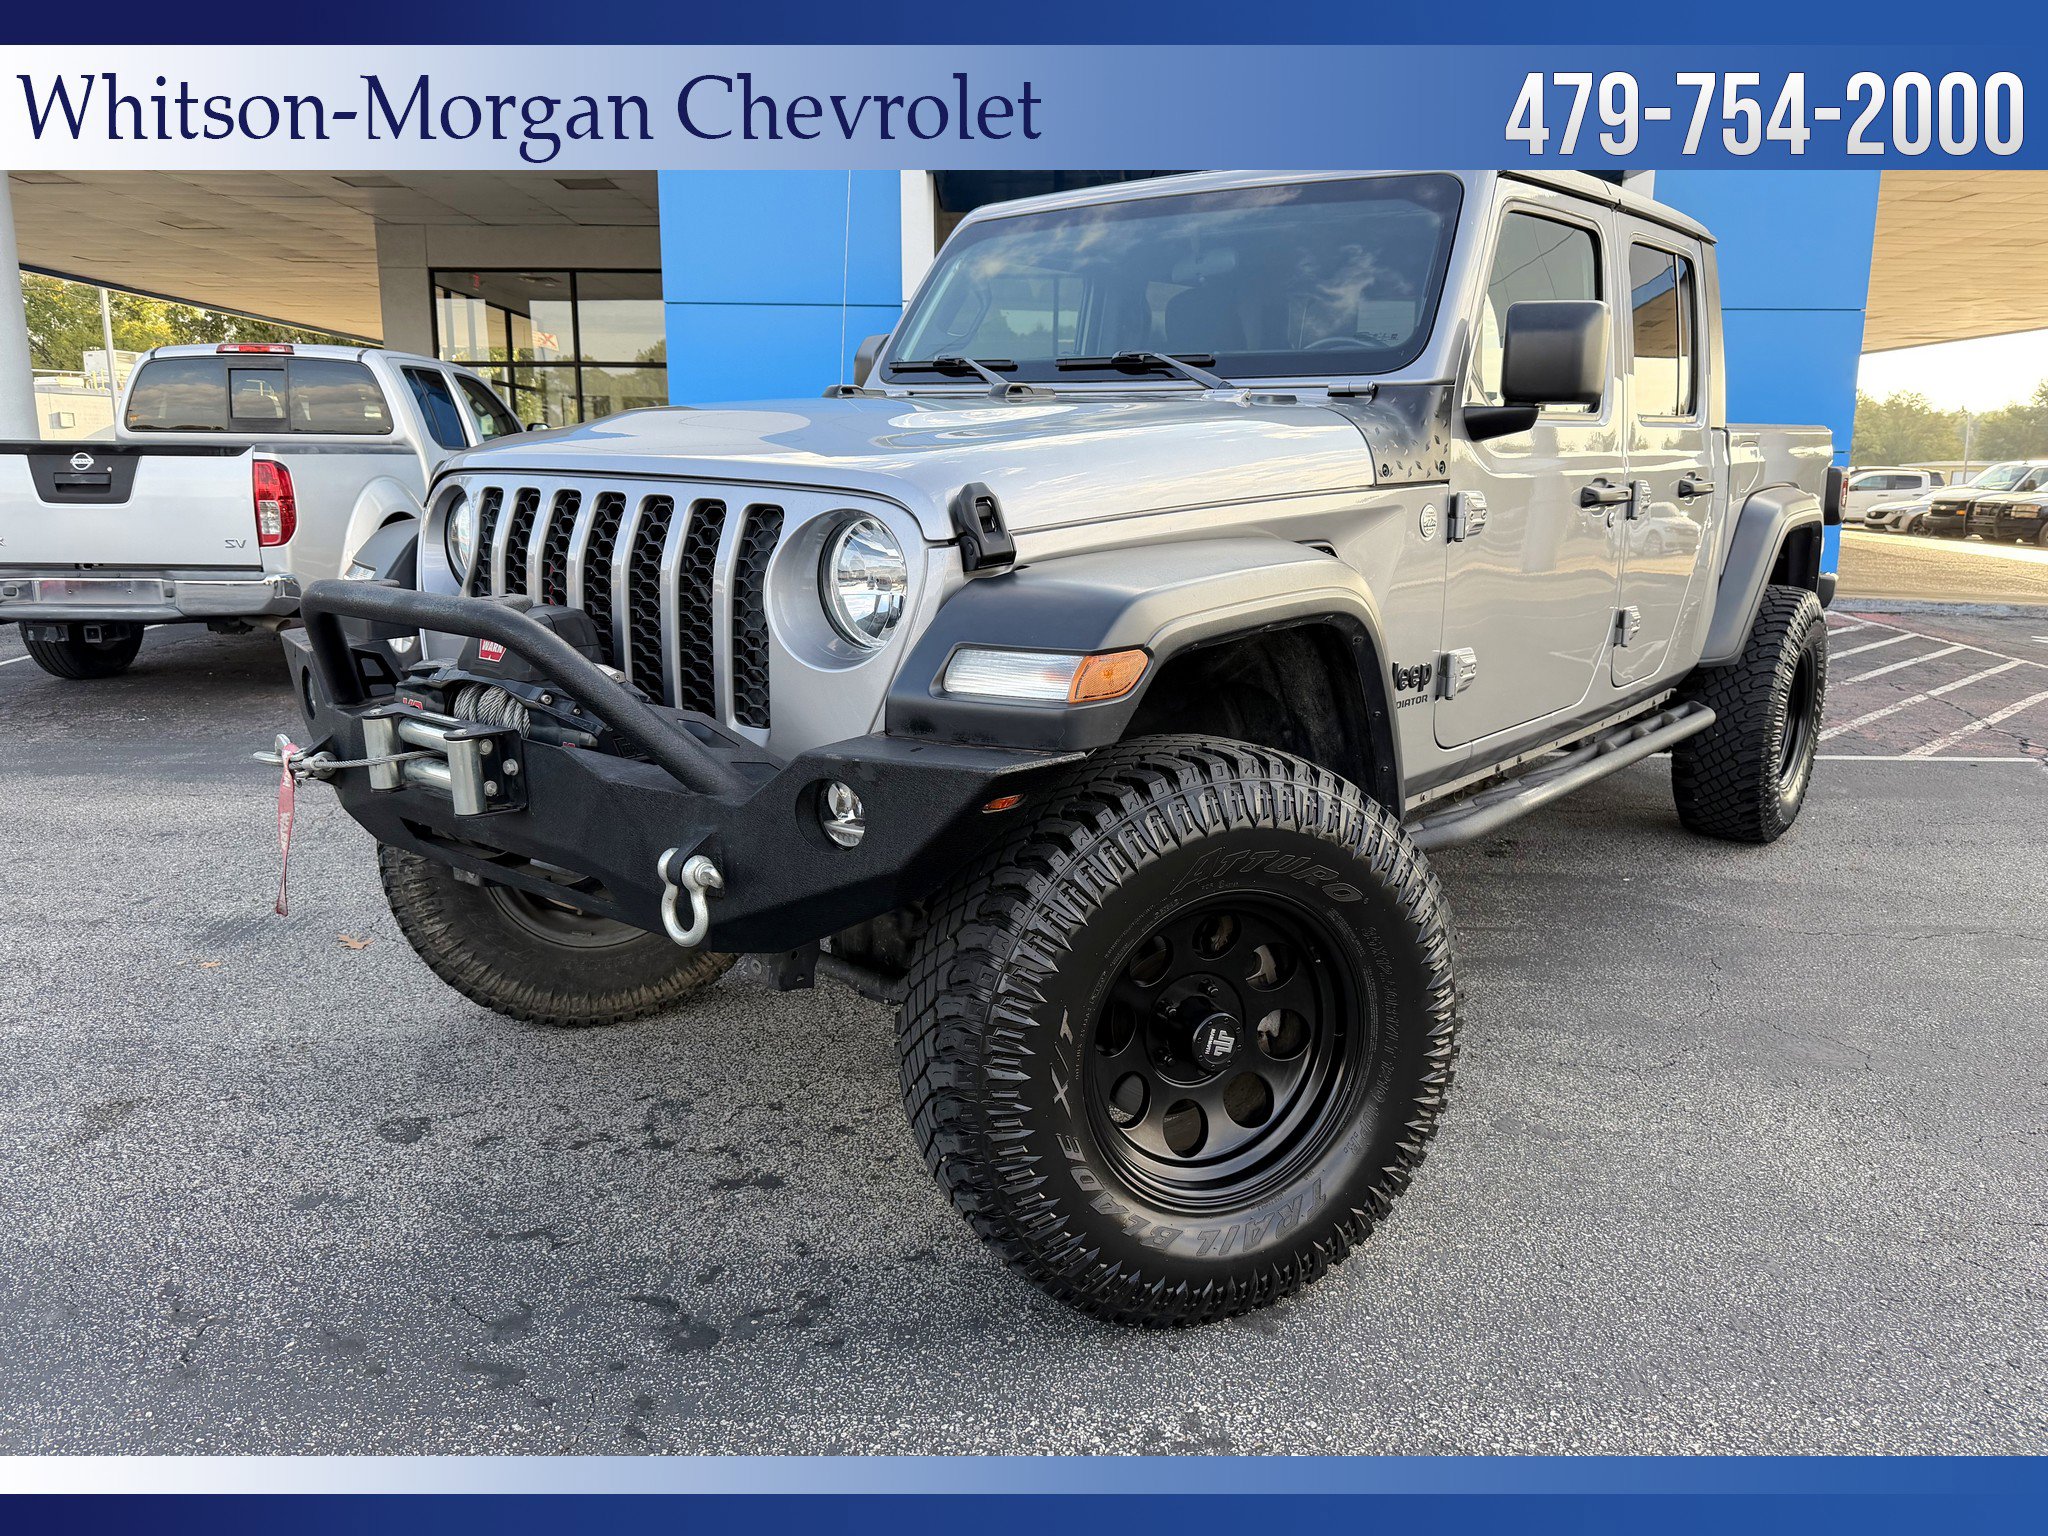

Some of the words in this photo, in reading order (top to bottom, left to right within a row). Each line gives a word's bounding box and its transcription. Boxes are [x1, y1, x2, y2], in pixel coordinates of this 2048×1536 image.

[225, 539, 246, 549] SV
[482, 640, 504, 653] WARN
[1391, 661, 1432, 692] Jeep
[1396, 694, 1429, 709] DIATOR
[1169, 846, 1365, 903] ATTURO
[1049, 1005, 1075, 1121] X/T
[1056, 1132, 1184, 1251] BLADE
[1195, 1177, 1329, 1258] TRAIL
